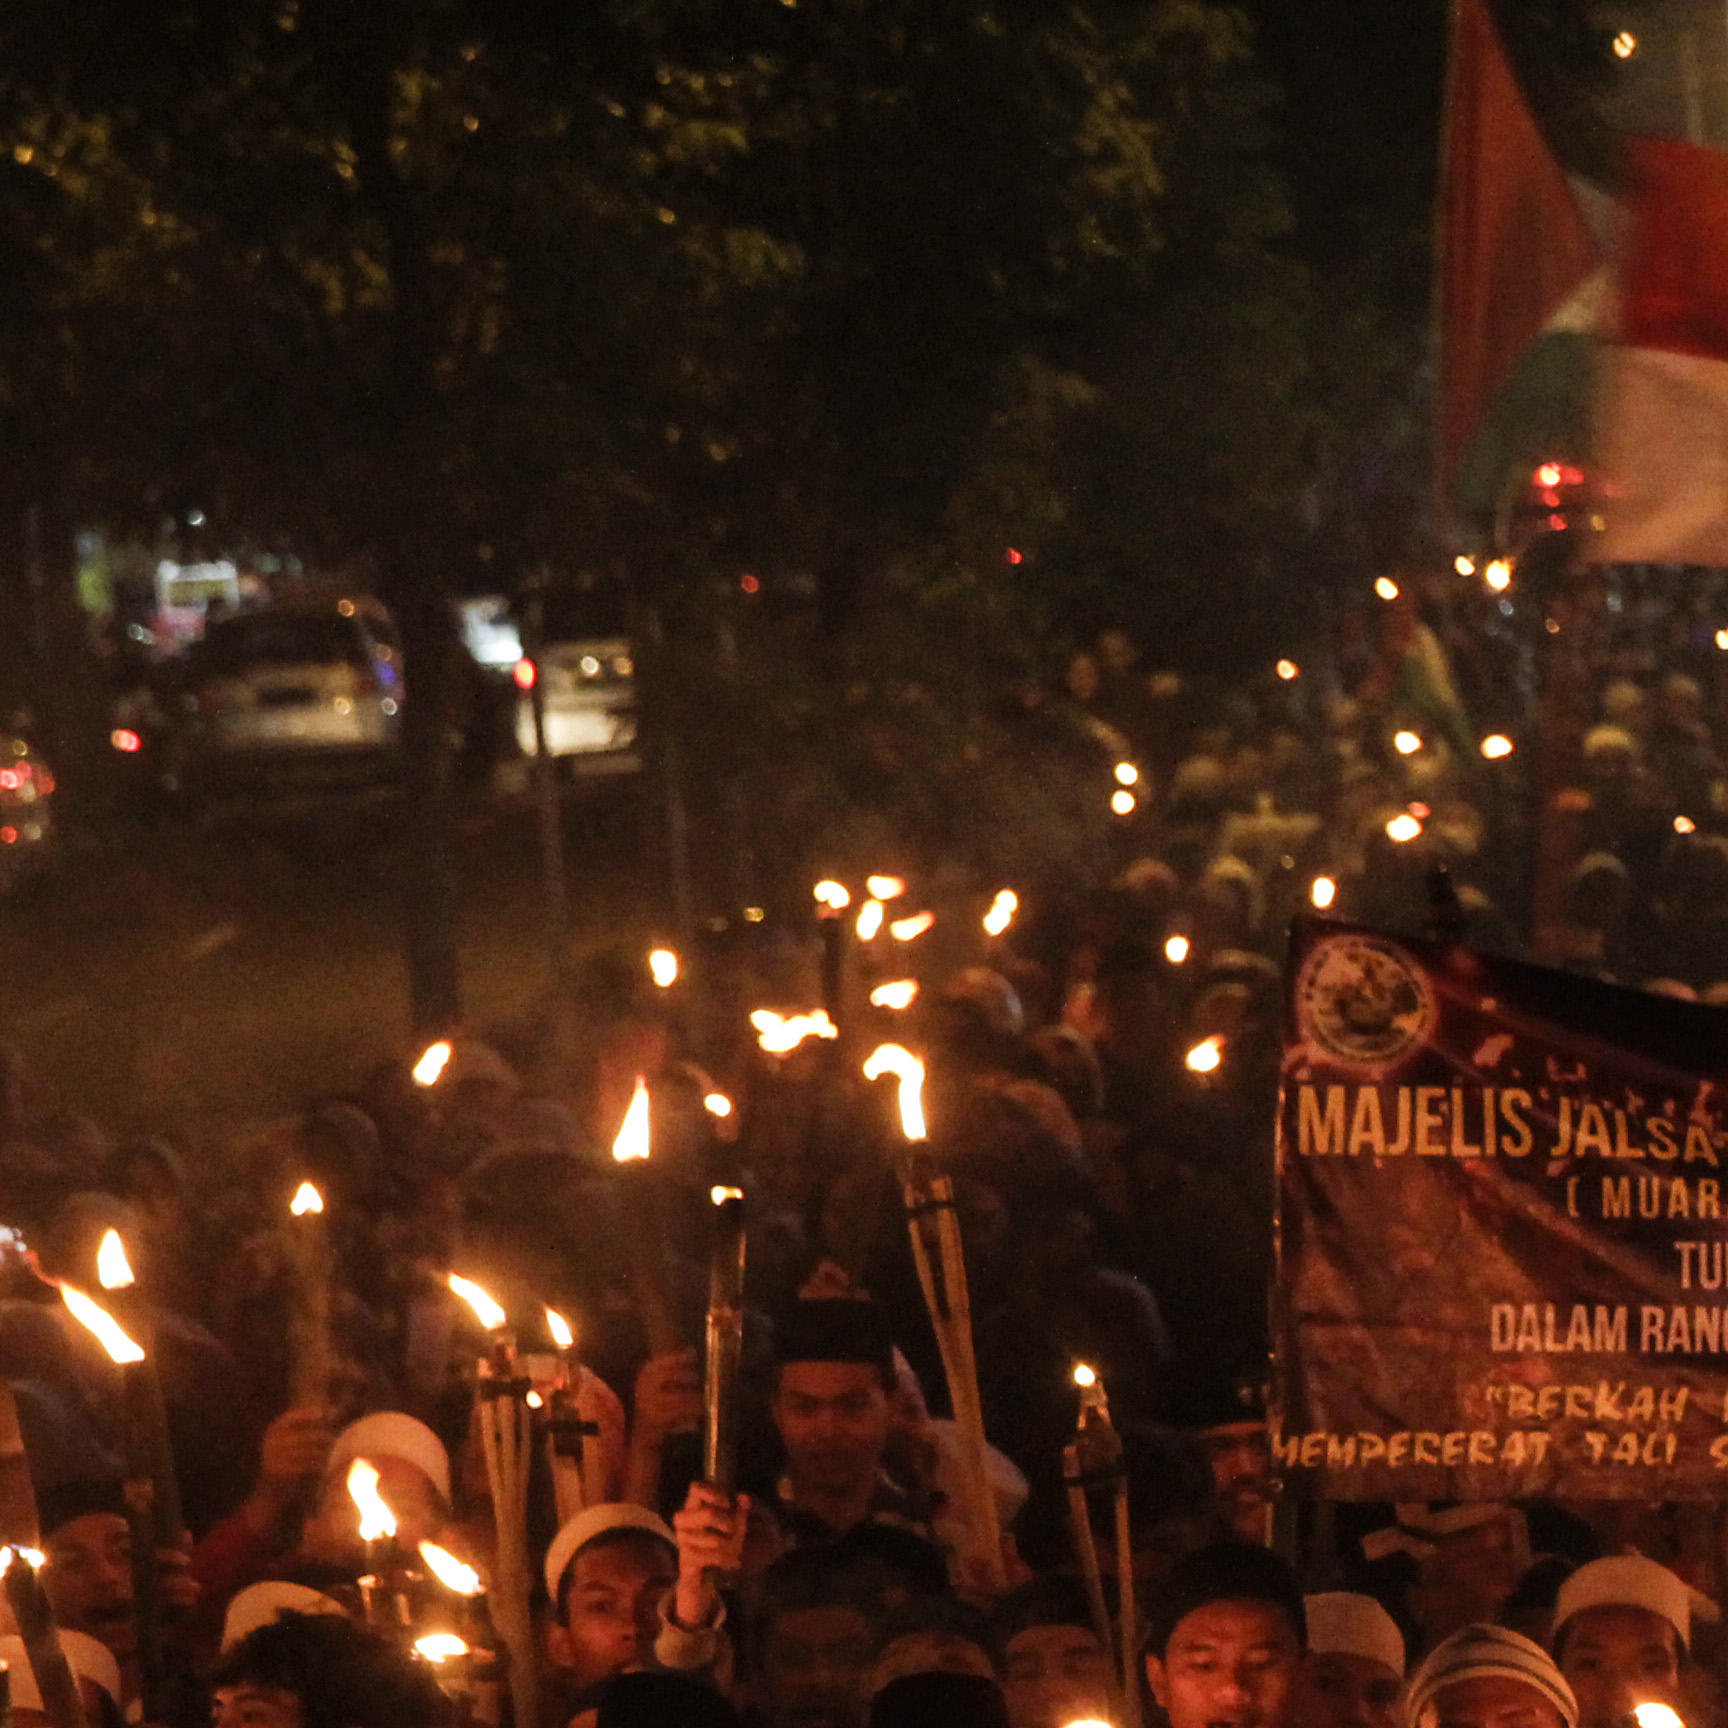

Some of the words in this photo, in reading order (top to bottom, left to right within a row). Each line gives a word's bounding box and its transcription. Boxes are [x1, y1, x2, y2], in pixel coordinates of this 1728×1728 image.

[1299, 1084, 1534, 1157] MAJELIS
[1490, 1302, 1629, 1353] DALAM
[1270, 1420, 1552, 1468] MEMPERERAT
[1585, 1430, 1678, 1466] TALI
